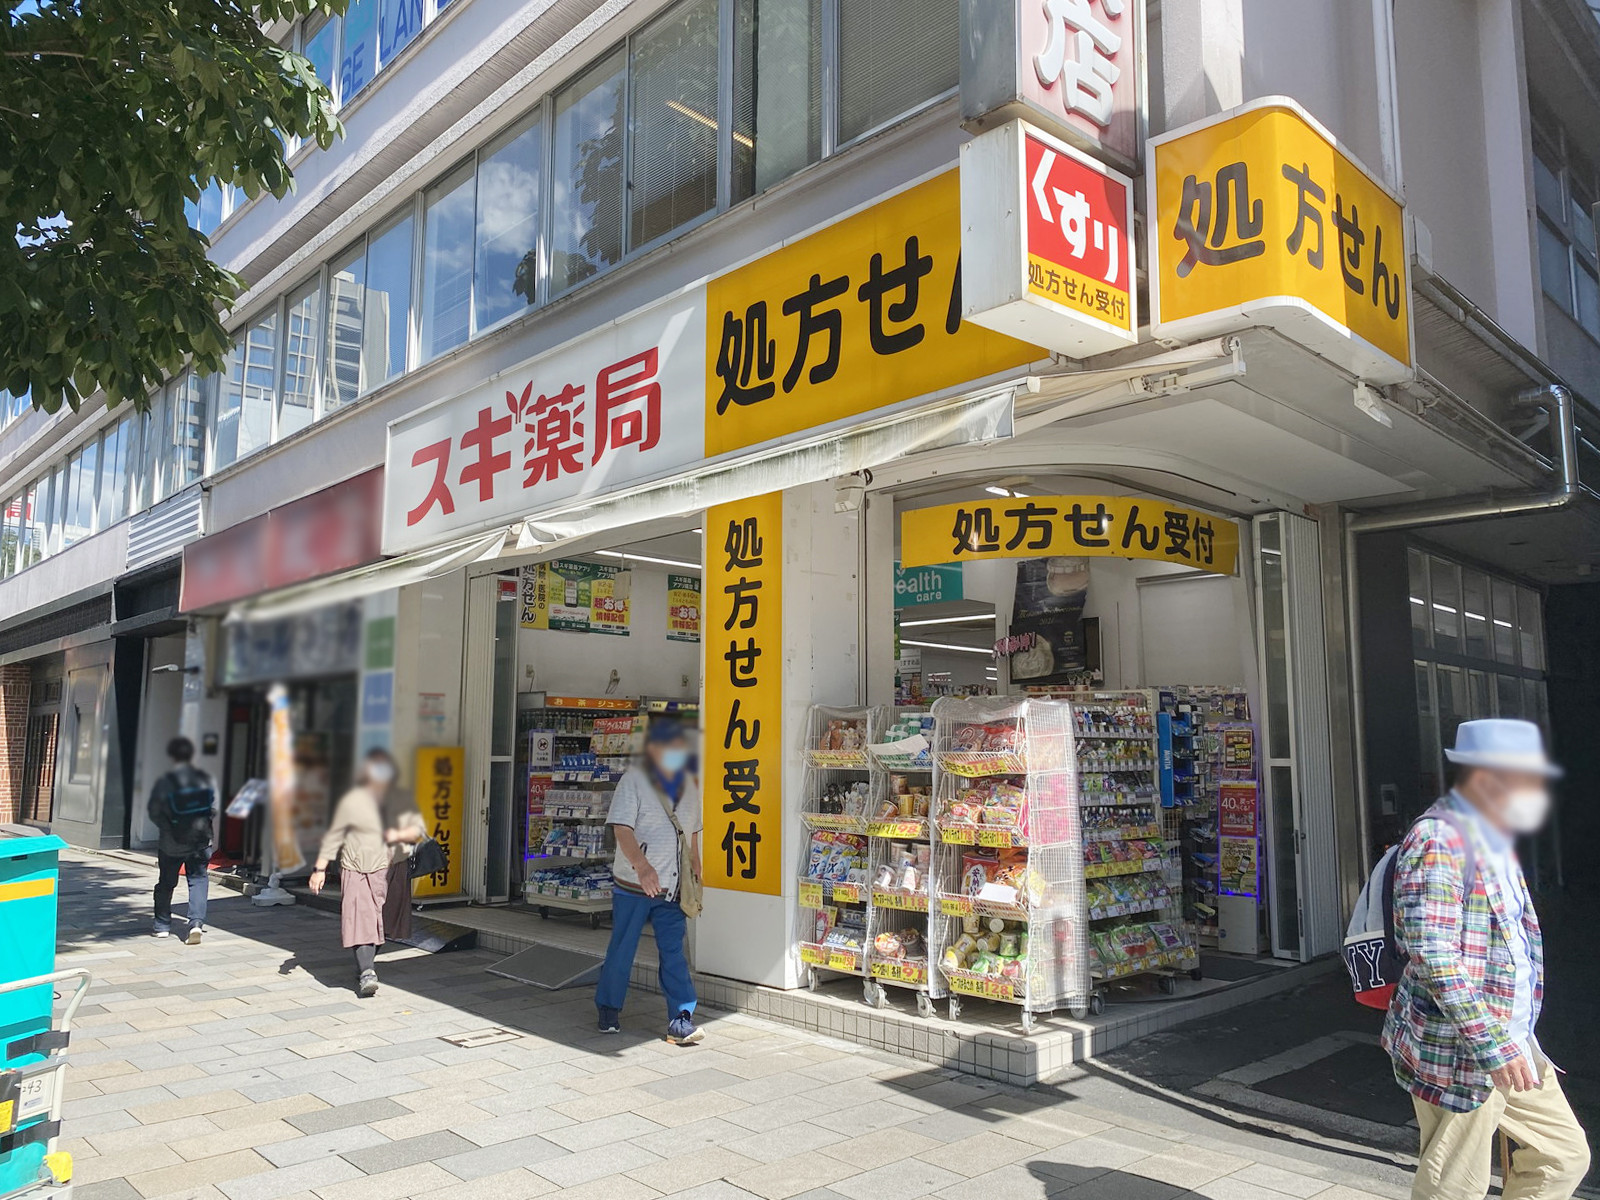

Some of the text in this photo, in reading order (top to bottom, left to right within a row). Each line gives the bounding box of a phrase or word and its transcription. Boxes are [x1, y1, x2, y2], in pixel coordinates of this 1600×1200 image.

[1032, 149, 1118, 283] くすり
[1174, 162, 1400, 320] 処方せん
[1028, 260, 1125, 320] 処方せん受付
[407, 346, 661, 527] スギ薬局
[953, 502, 1215, 564] 処方せん受付
[894, 570, 942, 595] ealth
[916, 591, 942, 602] care
[721, 516, 762, 880] 処方せん受付
[897, 823, 918, 834] 98
[902, 967, 923, 980] 91
[985, 980, 1009, 995] 128
